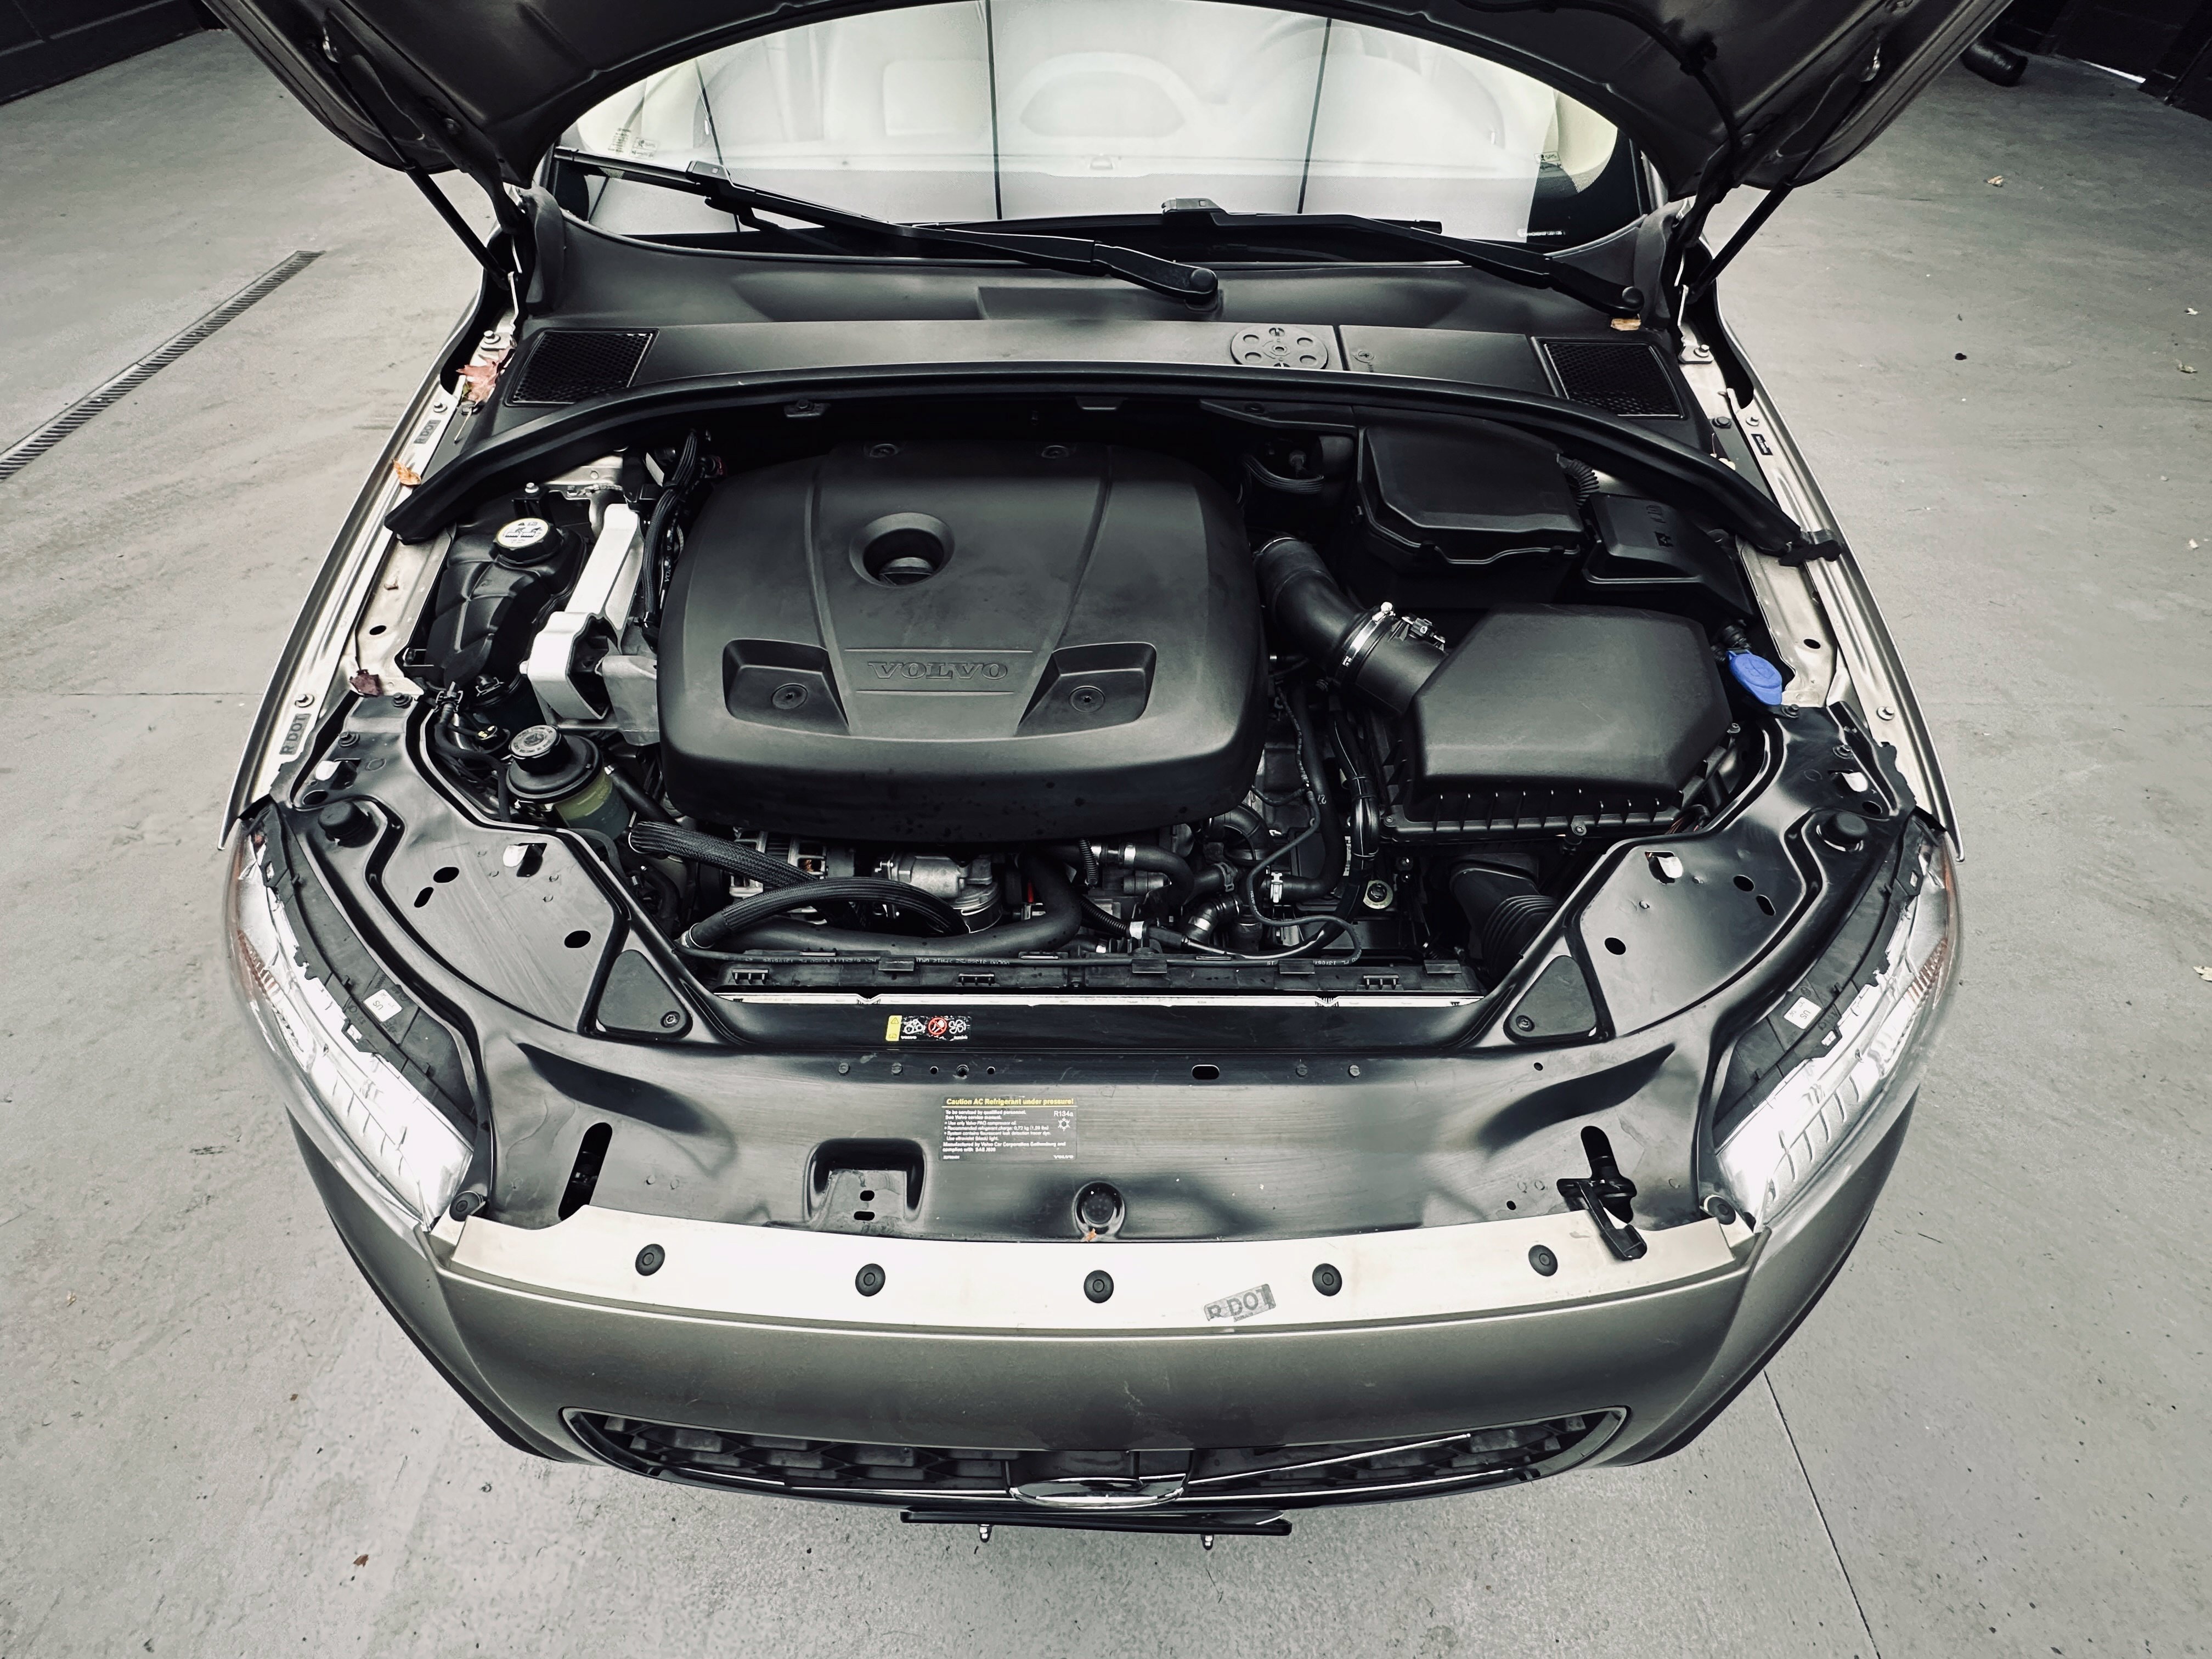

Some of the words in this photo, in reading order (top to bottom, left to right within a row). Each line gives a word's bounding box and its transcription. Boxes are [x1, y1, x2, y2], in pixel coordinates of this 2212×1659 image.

[420, 421, 437, 436] DOT
[868, 662, 1008, 680] VOLVO
[286, 715, 307, 741] DOT
[373, 1000, 383, 1011] US
[1799, 1010, 1811, 1019] US
[1227, 1285, 1269, 1316] DOT
